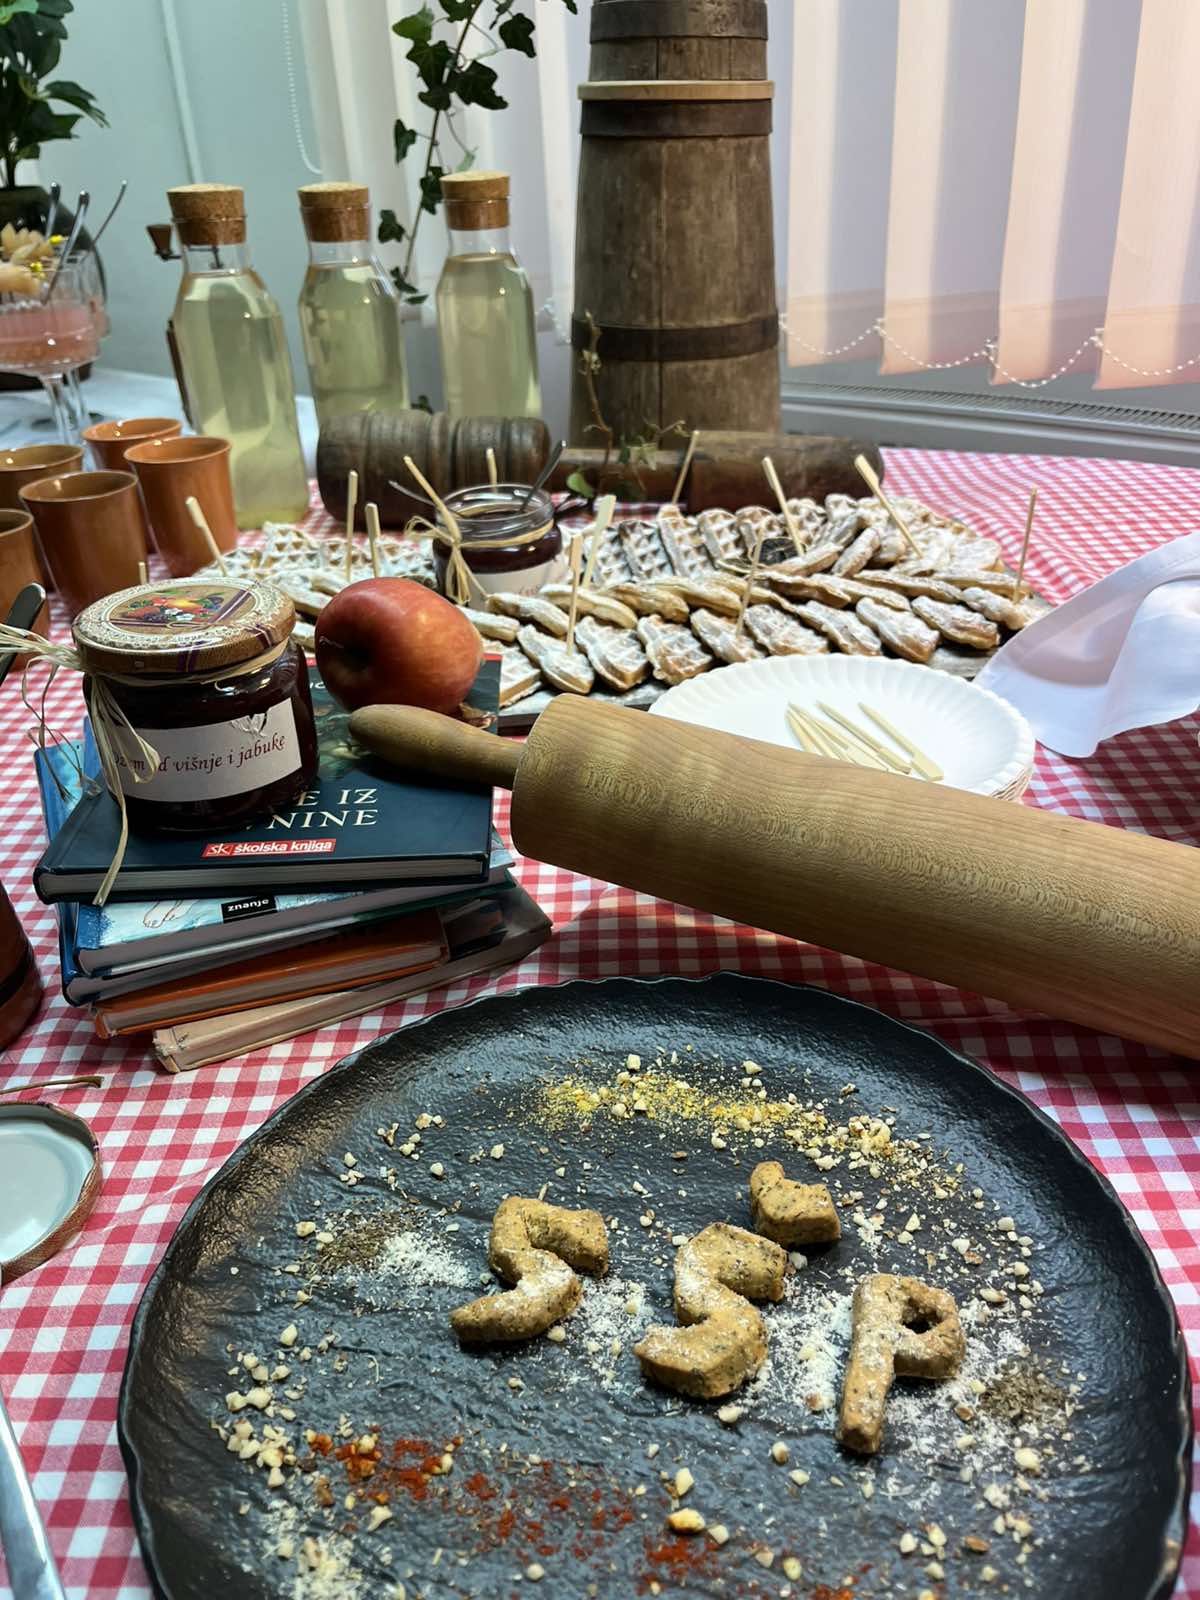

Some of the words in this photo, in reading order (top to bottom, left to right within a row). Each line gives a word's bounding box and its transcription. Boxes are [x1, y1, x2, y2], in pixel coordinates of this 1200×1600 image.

[174, 755, 223, 775] višnje
[227, 749, 235, 766] i
[236, 732, 286, 768] jabuke
[337, 788, 378, 805] IZ
[265, 809, 378, 830] NINE
[234, 842, 288, 853] školska
[290, 840, 333, 852] knjiga
[226, 898, 270, 912] znanje
